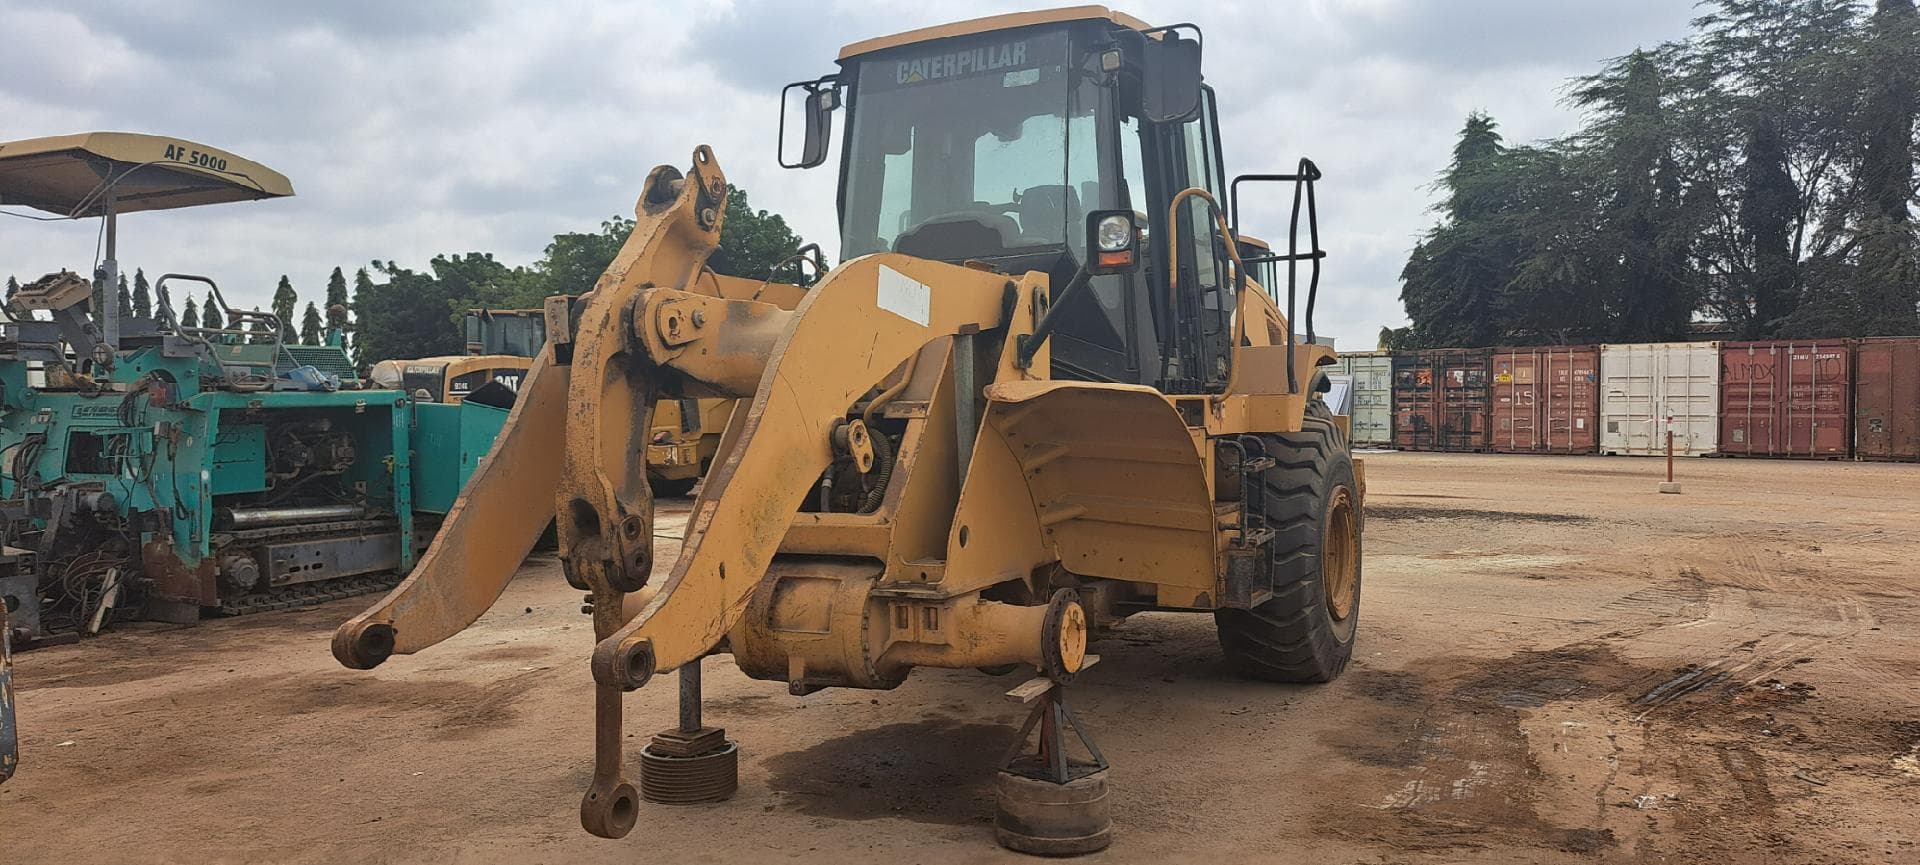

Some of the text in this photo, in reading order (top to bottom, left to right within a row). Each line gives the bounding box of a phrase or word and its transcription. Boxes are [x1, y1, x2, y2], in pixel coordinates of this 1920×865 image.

[896, 41, 1026, 84] CATERPILLAR
[164, 144, 227, 171] AF 5000
[1515, 391, 1534, 406] 15
